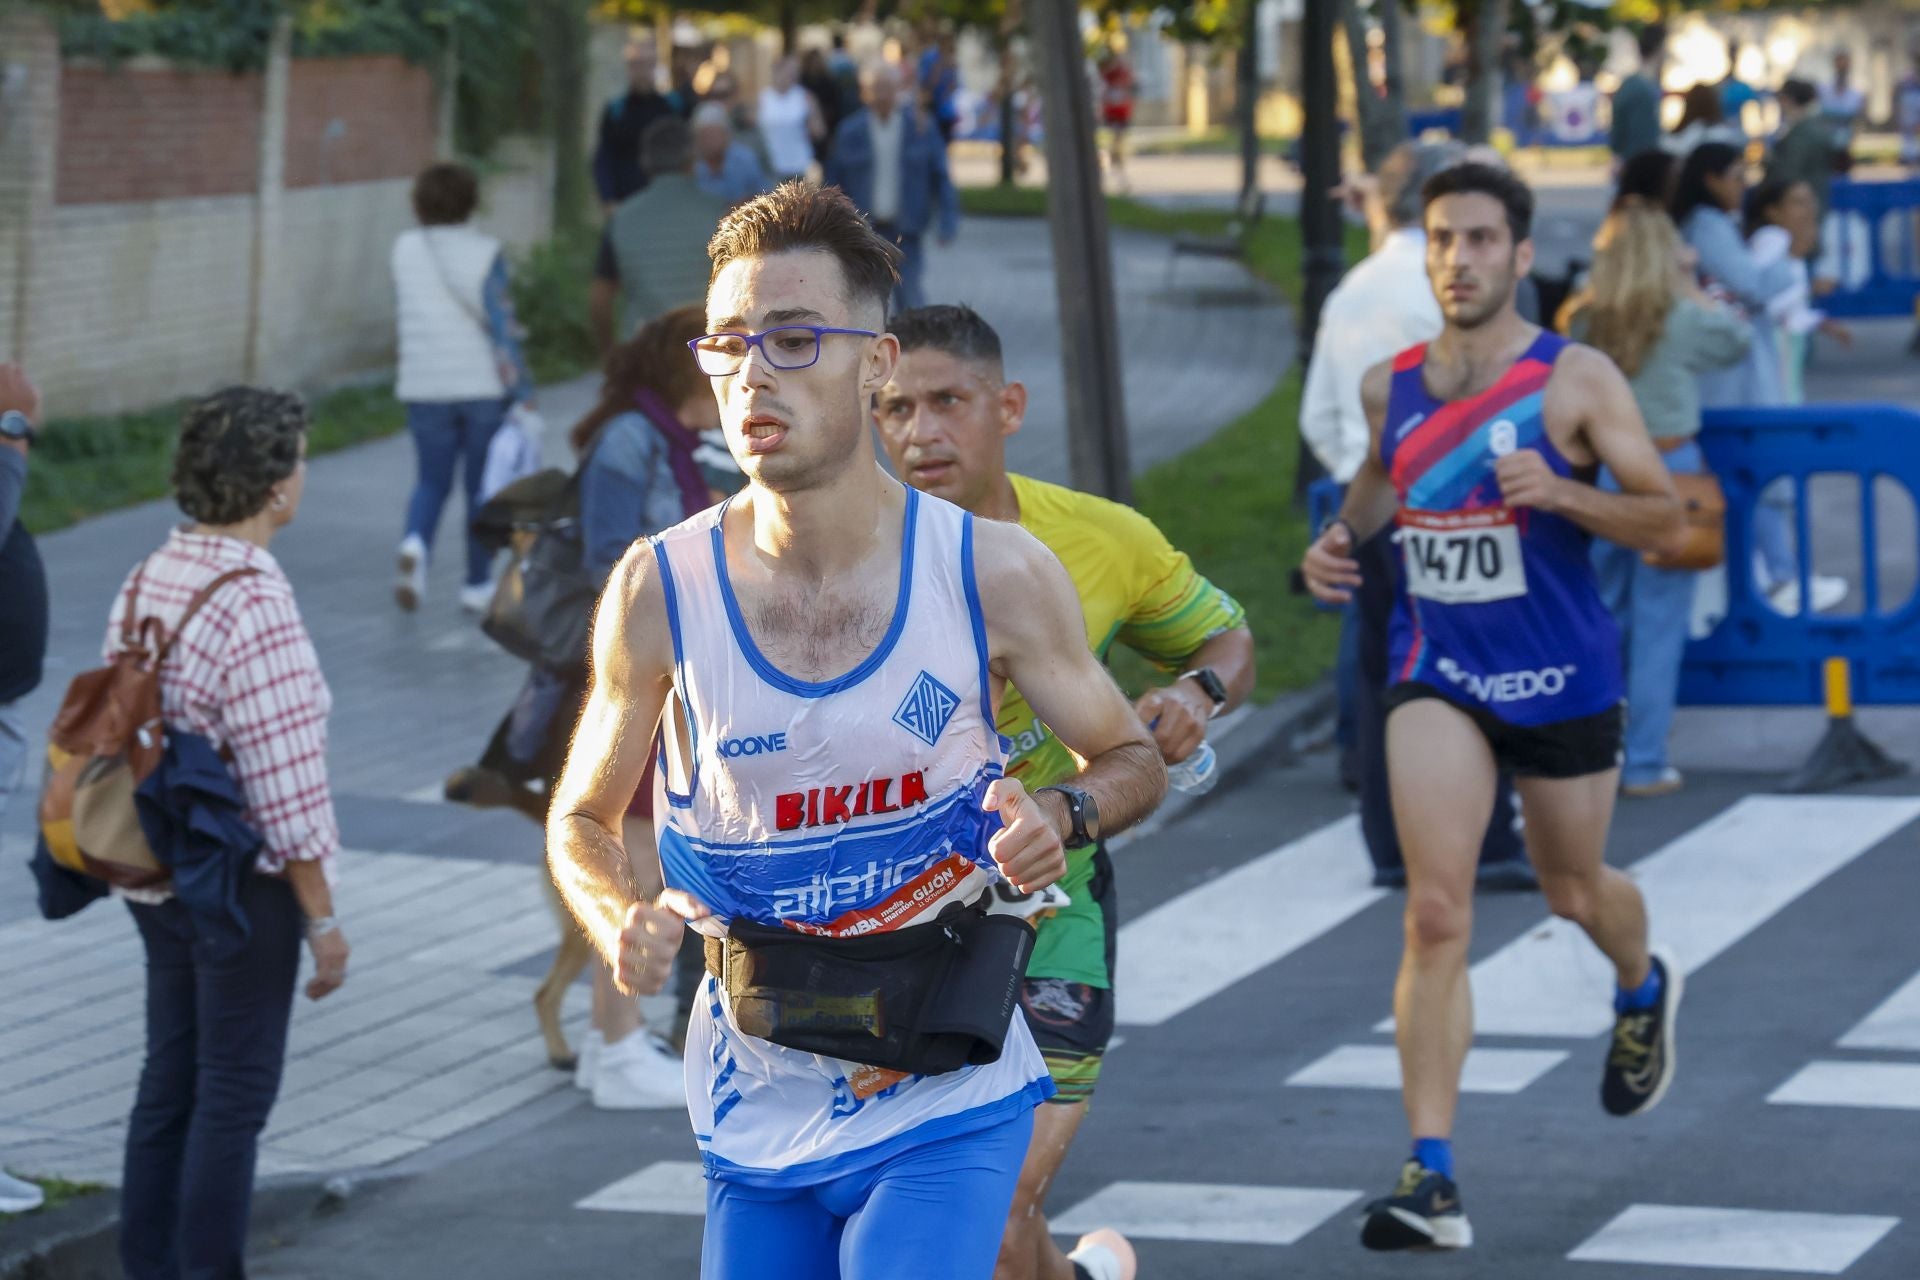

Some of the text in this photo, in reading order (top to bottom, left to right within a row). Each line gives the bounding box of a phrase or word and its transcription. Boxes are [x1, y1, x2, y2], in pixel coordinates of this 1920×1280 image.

[1411, 534, 1502, 582] 1470
[776, 770, 929, 831] BIKILA
[912, 867, 954, 900] GIJÓN
[880, 900, 905, 917] media
[883, 900, 915, 923] maratón
[1001, 974, 1016, 1018] KIPRUN
